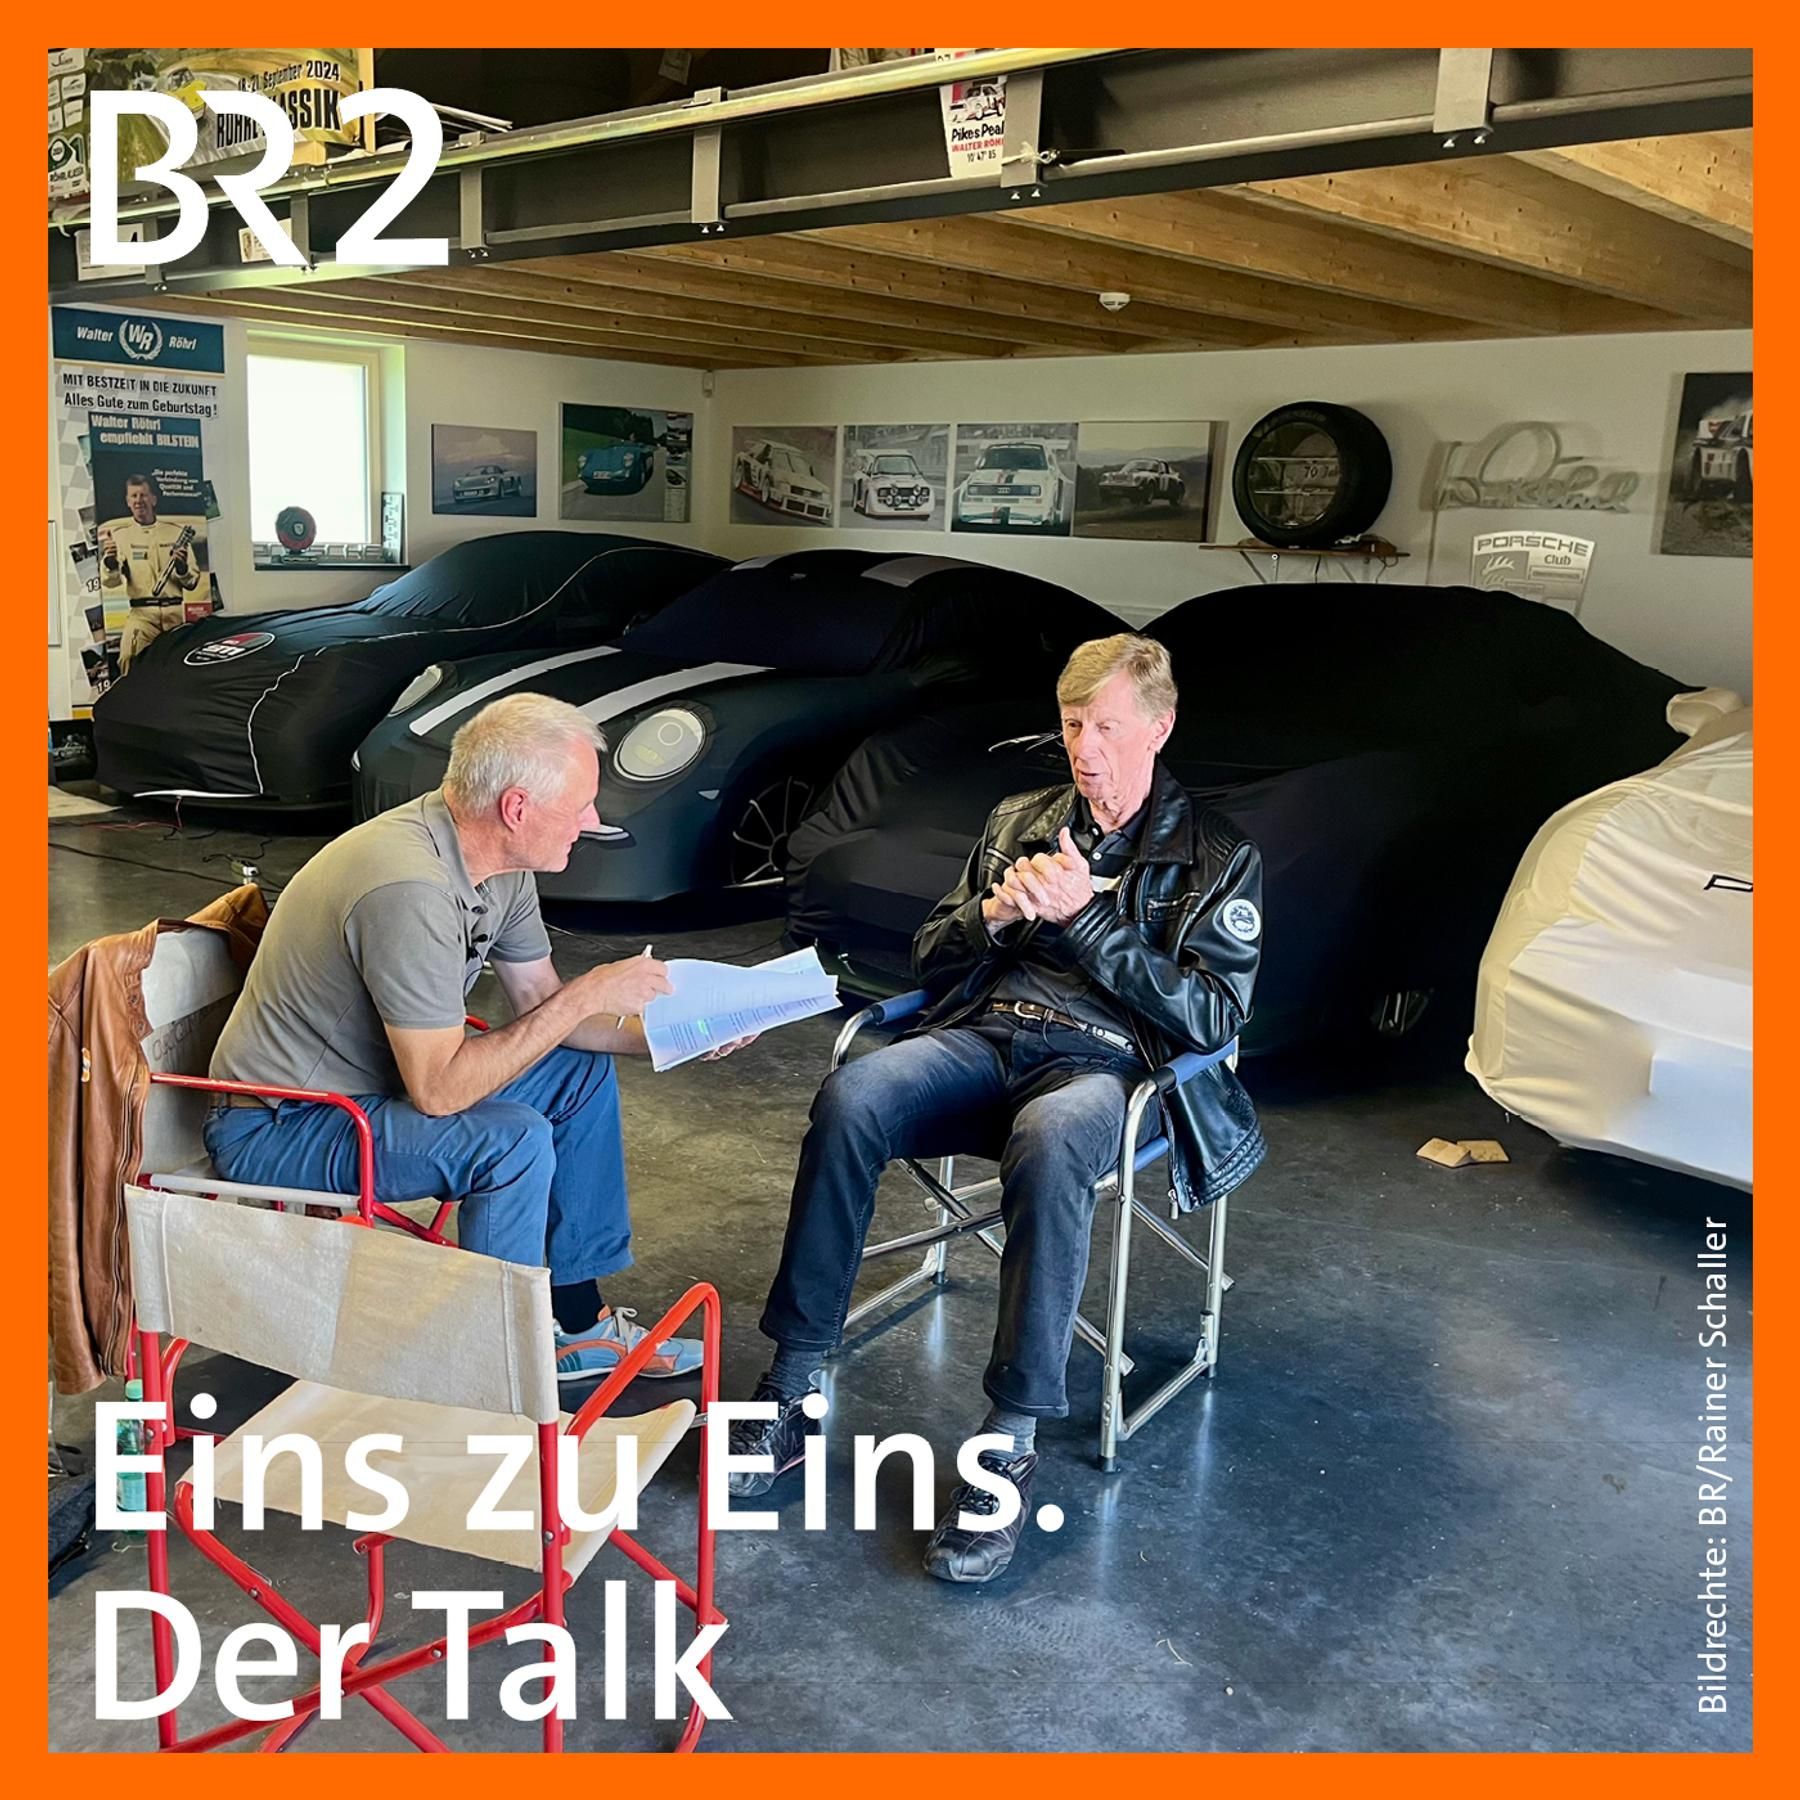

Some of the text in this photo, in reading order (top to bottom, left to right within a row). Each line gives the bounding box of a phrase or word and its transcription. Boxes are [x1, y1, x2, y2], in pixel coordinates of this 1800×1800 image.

[264, 64, 302, 89] September
[306, 60, 340, 81] 2024
[951, 120, 1005, 142] Pikes Pea
[77, 326, 113, 342] Walter
[169, 336, 197, 350] Röhrl
[63, 373, 217, 397] MIT BESTZEIT IN DIE ZUKUNFT
[65, 393, 94, 406] Alles
[97, 395, 123, 409] Gute
[127, 400, 149, 410] zum
[91, 415, 161, 430] Walter Röhrl
[100, 432, 199, 448] empfiehlt BILSTEIN
[1477, 535, 1589, 557] PORSCHE
[1544, 553, 1571, 567] Club
